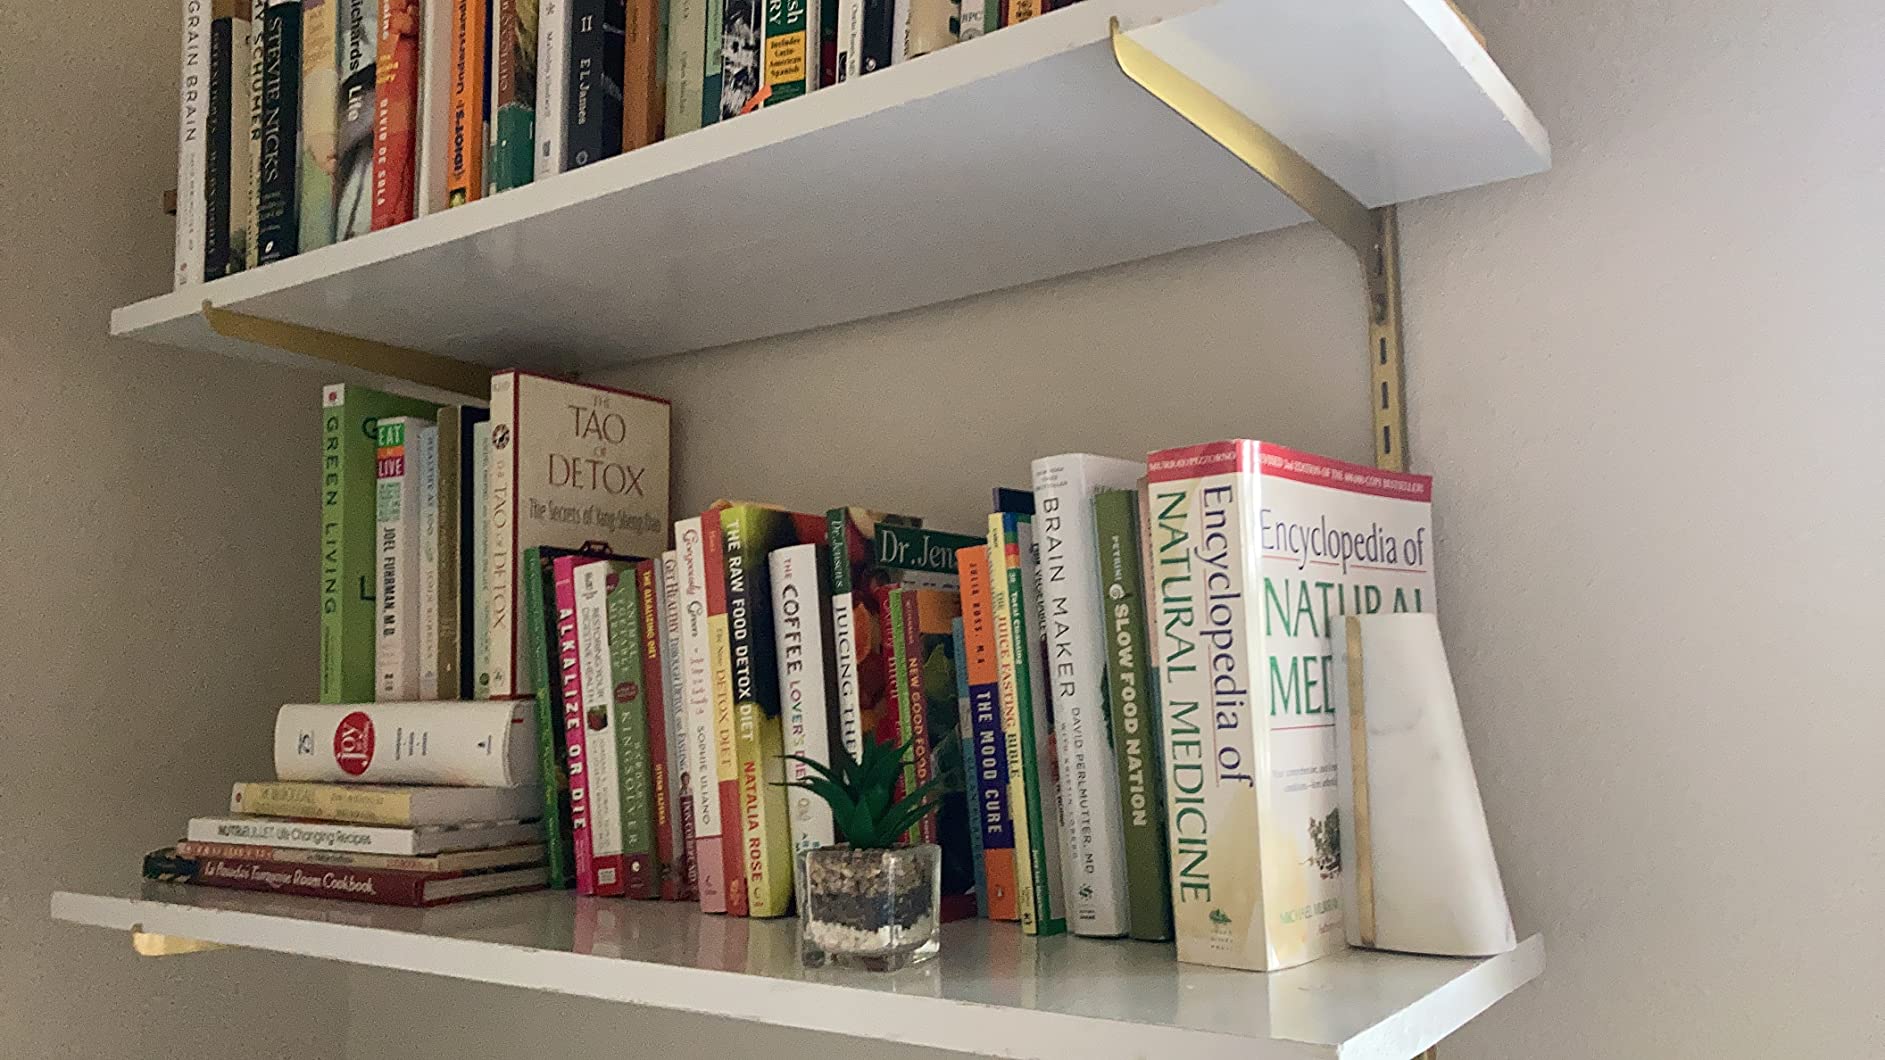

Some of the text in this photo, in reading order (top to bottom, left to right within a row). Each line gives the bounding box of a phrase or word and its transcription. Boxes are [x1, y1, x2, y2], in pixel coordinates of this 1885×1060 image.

[187, 1, 200, 66] GRAIN
[267, 16, 281, 100] STEVIE
[348, 0, 362, 122] ichards Life
[185, 75, 198, 142] BRAIN
[251, 31, 263, 140] SCHUMER
[578, 82, 589, 125] James
[264, 106, 280, 183] NICKS
[377, 98, 388, 206] DAVID DE SOLA
[325, 416, 339, 506] GREEN
[378, 425, 400, 446] EAT
[568, 405, 626, 445] TAO
[378, 458, 403, 477] LIVE
[549, 453, 645, 497] DETOX
[325, 522, 337, 614] LIVING
[383, 527, 396, 551] JOEL
[493, 486, 507, 631] TAO DETOX
[918, 535, 956, 569] Jen
[1111, 535, 1122, 580] PETRINI
[1260, 509, 1426, 575] Encyclopedia of
[643, 571, 651, 587] THE
[666, 581, 681, 632] HEALTHY
[683, 529, 703, 637] Gorgeously Green
[969, 562, 979, 596] JULIA
[1043, 498, 1076, 698] BRAIN MAKER
[727, 519, 755, 741] THE RAW FOOD DETOX DIET
[836, 606, 852, 696] JUICING
[999, 617, 1010, 659] JUICE
[1012, 592, 1023, 665] Total Cleansing
[1195, 485, 1254, 788] Encyclopedia of
[559, 608, 580, 728] ALKALIZE
[716, 670, 729, 726] DETOX
[782, 558, 807, 779] THE COFFEE LOVER'S DIE
[1001, 663, 1016, 728] FASTING
[1157, 491, 1211, 902] NATURAL MEDICINE
[719, 730, 731, 767] DIET
[909, 657, 926, 779] NEW GOOD FOOD
[1115, 603, 1147, 826] SLOW FOOD NATION
[568, 744, 583, 776] OR
[621, 711, 637, 845] KINGSOLVER
[698, 725, 711, 826] SOPHIE ULIANO
[977, 691, 1003, 833] THE MOOD CURE
[1007, 733, 1020, 778] BIBLE
[1072, 707, 1095, 875] DAVID PERLMUTTER, MD
[571, 788, 586, 830] DIE
[744, 760, 763, 882] NATALIA ROSE
[293, 870, 321, 888] Room
[322, 872, 376, 896] Cookbook
